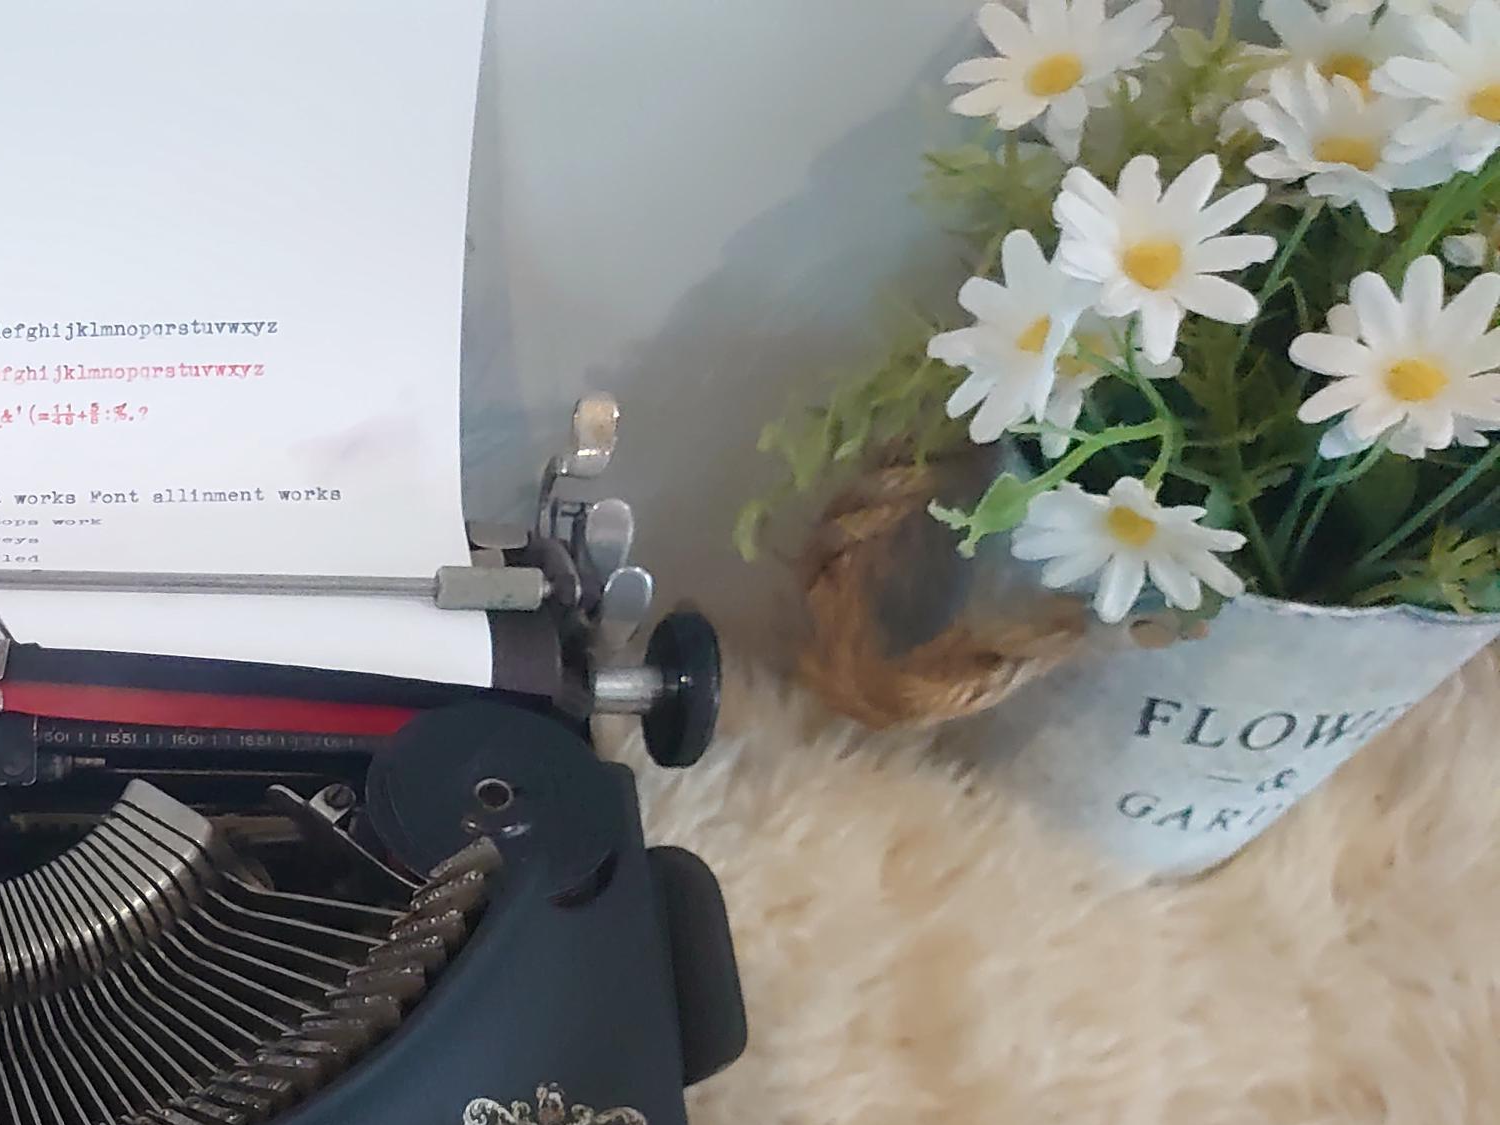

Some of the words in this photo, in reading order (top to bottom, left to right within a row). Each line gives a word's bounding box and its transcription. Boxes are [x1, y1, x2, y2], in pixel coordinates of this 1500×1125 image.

[14, 490, 77, 505] works
[90, 489, 140, 504] Font
[152, 487, 265, 504] allinment
[278, 486, 342, 502] works
[51, 518, 103, 526] work
